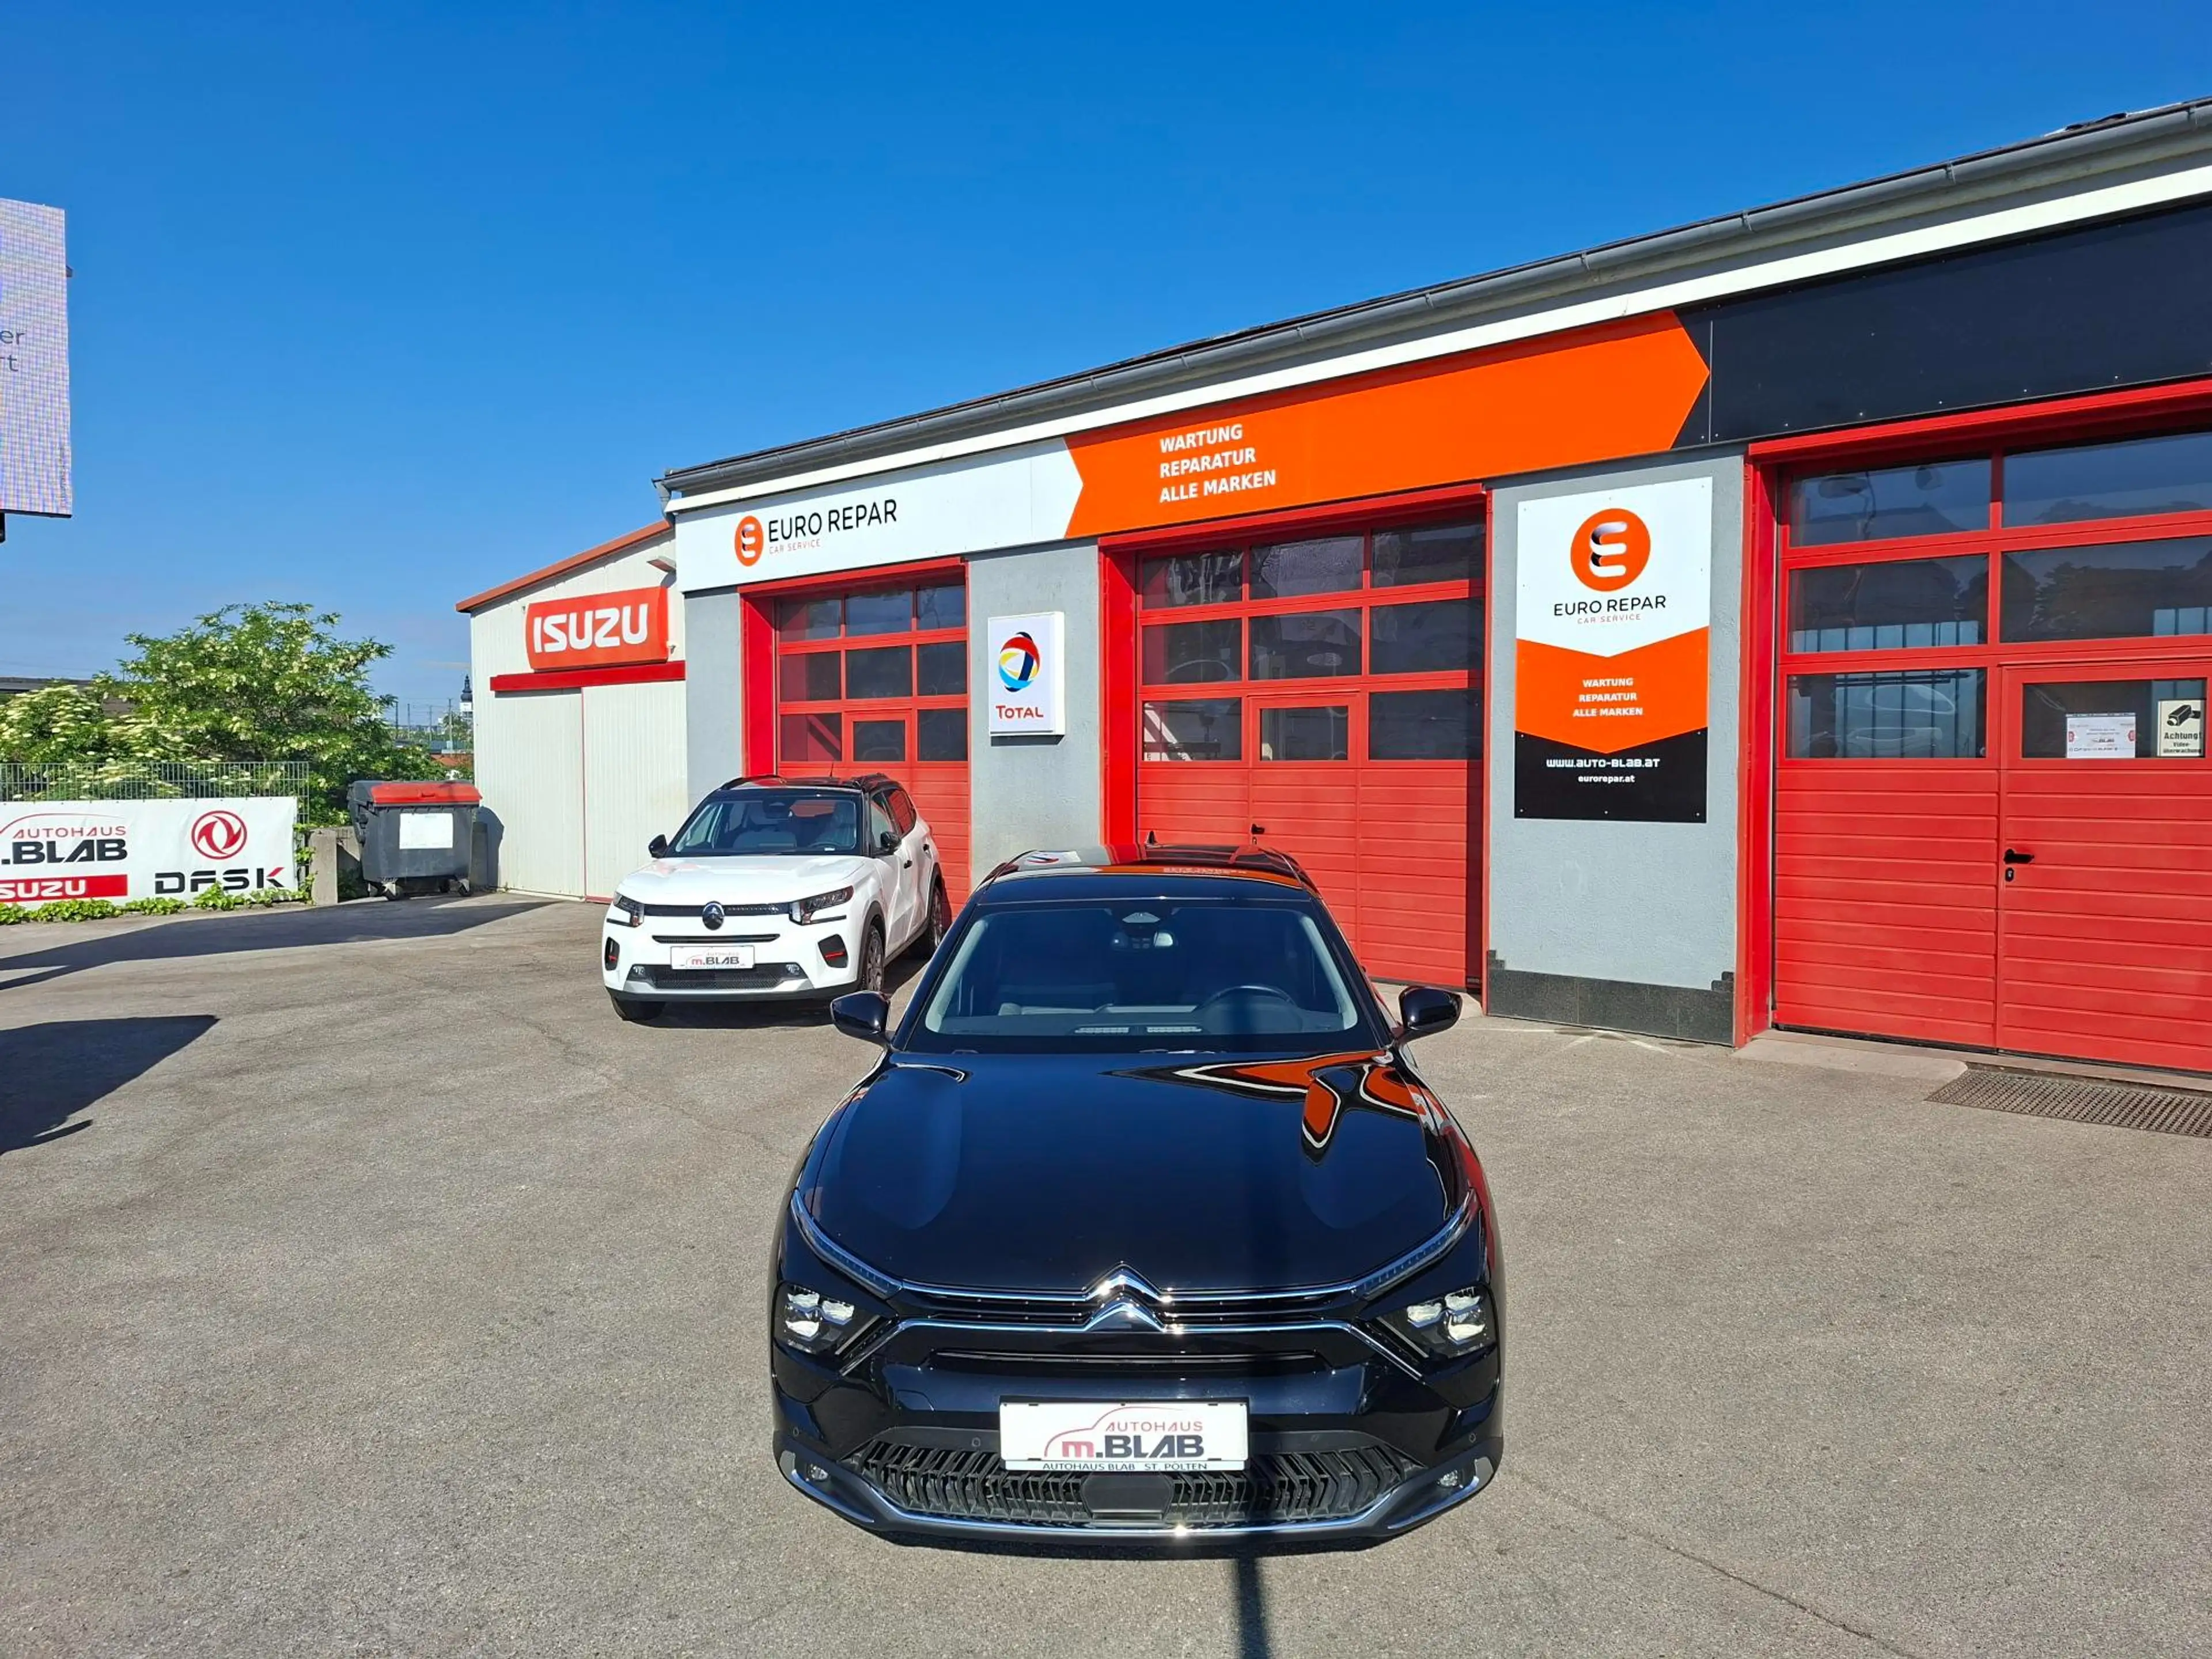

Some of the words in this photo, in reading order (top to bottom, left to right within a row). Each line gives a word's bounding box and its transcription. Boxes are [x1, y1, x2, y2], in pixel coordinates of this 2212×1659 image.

[1160, 424, 1243, 453] WARTUNG
[1160, 448, 1256, 478] REPARATUR
[1160, 483, 1198, 503] ALLE
[1204, 469, 1276, 496] MARKEN
[769, 513, 822, 542] EURO
[828, 499, 896, 532] REPAR
[769, 545, 784, 554] CAR
[787, 539, 821, 551] SERVICE
[1554, 600, 1602, 616] EURO
[1607, 595, 1666, 612] REPAR
[1600, 614, 1641, 622] SERVICE
[533, 603, 648, 653] ISUZU
[1583, 678, 1633, 688] WARTUNG
[1579, 692, 1637, 702] REPARATUR
[995, 706, 1043, 719] TOTAL
[1573, 709, 1597, 717] ALLE
[1600, 707, 1643, 716] MARKEN
[1578, 775, 1635, 783] eurorepar.at
[13, 826, 127, 839] AUTOHAUS
[155, 867, 285, 895] DFSK
[692, 957, 740, 965] m.BLAB
[1105, 1421, 1203, 1432] AUTOHAUS
[1062, 1434, 1205, 1459] m.BLAB
